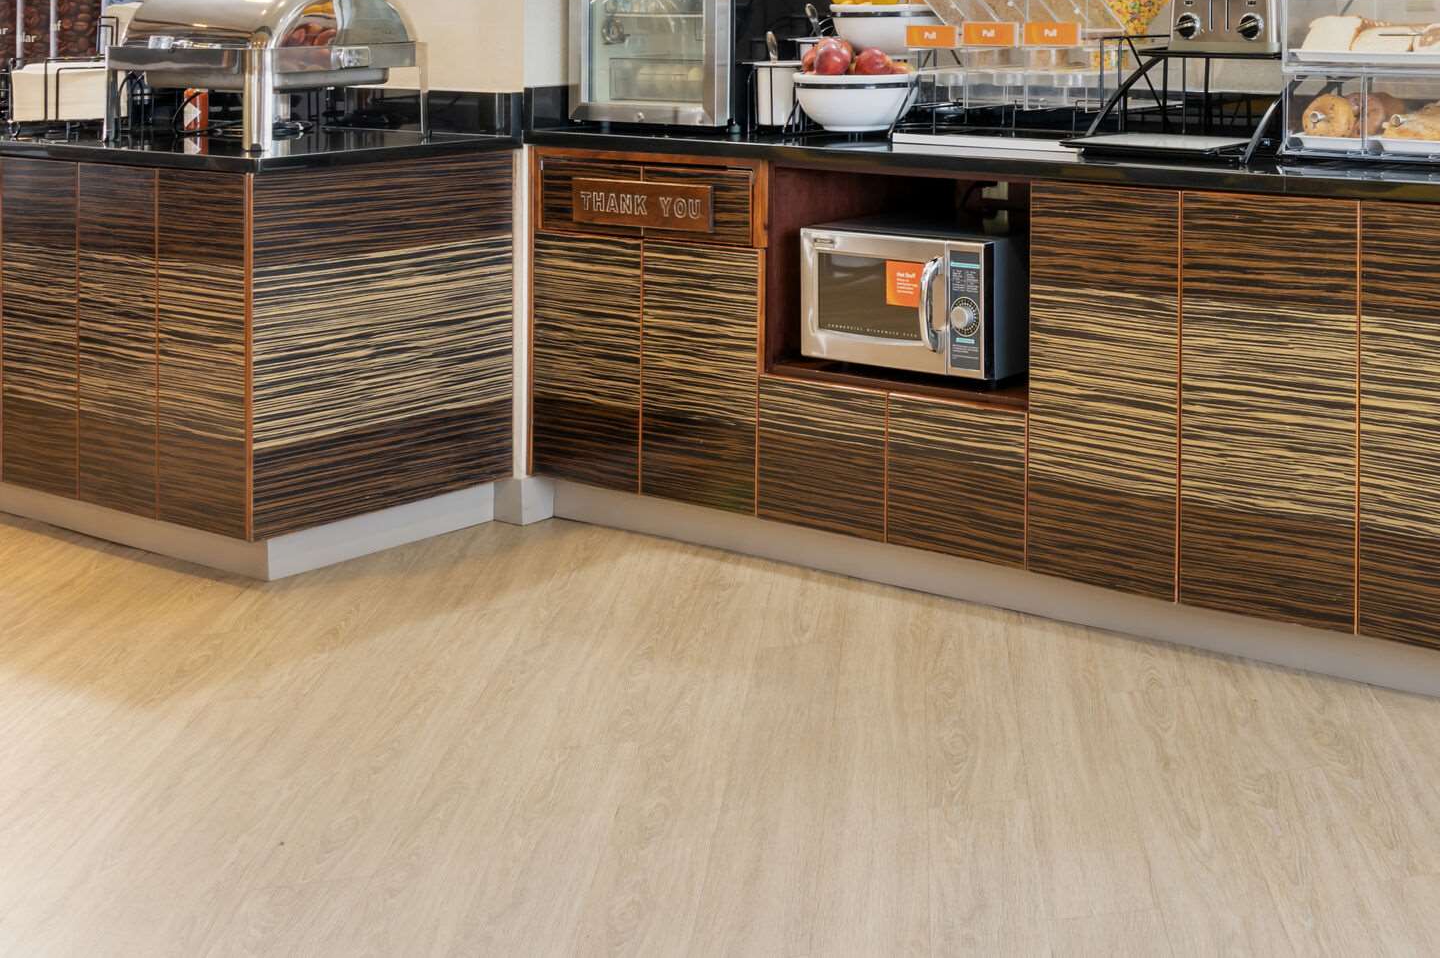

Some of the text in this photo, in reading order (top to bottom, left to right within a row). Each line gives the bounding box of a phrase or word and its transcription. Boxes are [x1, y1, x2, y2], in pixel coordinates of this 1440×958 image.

[923, 31, 936, 40] Pull
[981, 29, 995, 38] Pull
[1043, 29, 1057, 38] Pull
[580, 191, 702, 220] THANK YOU
